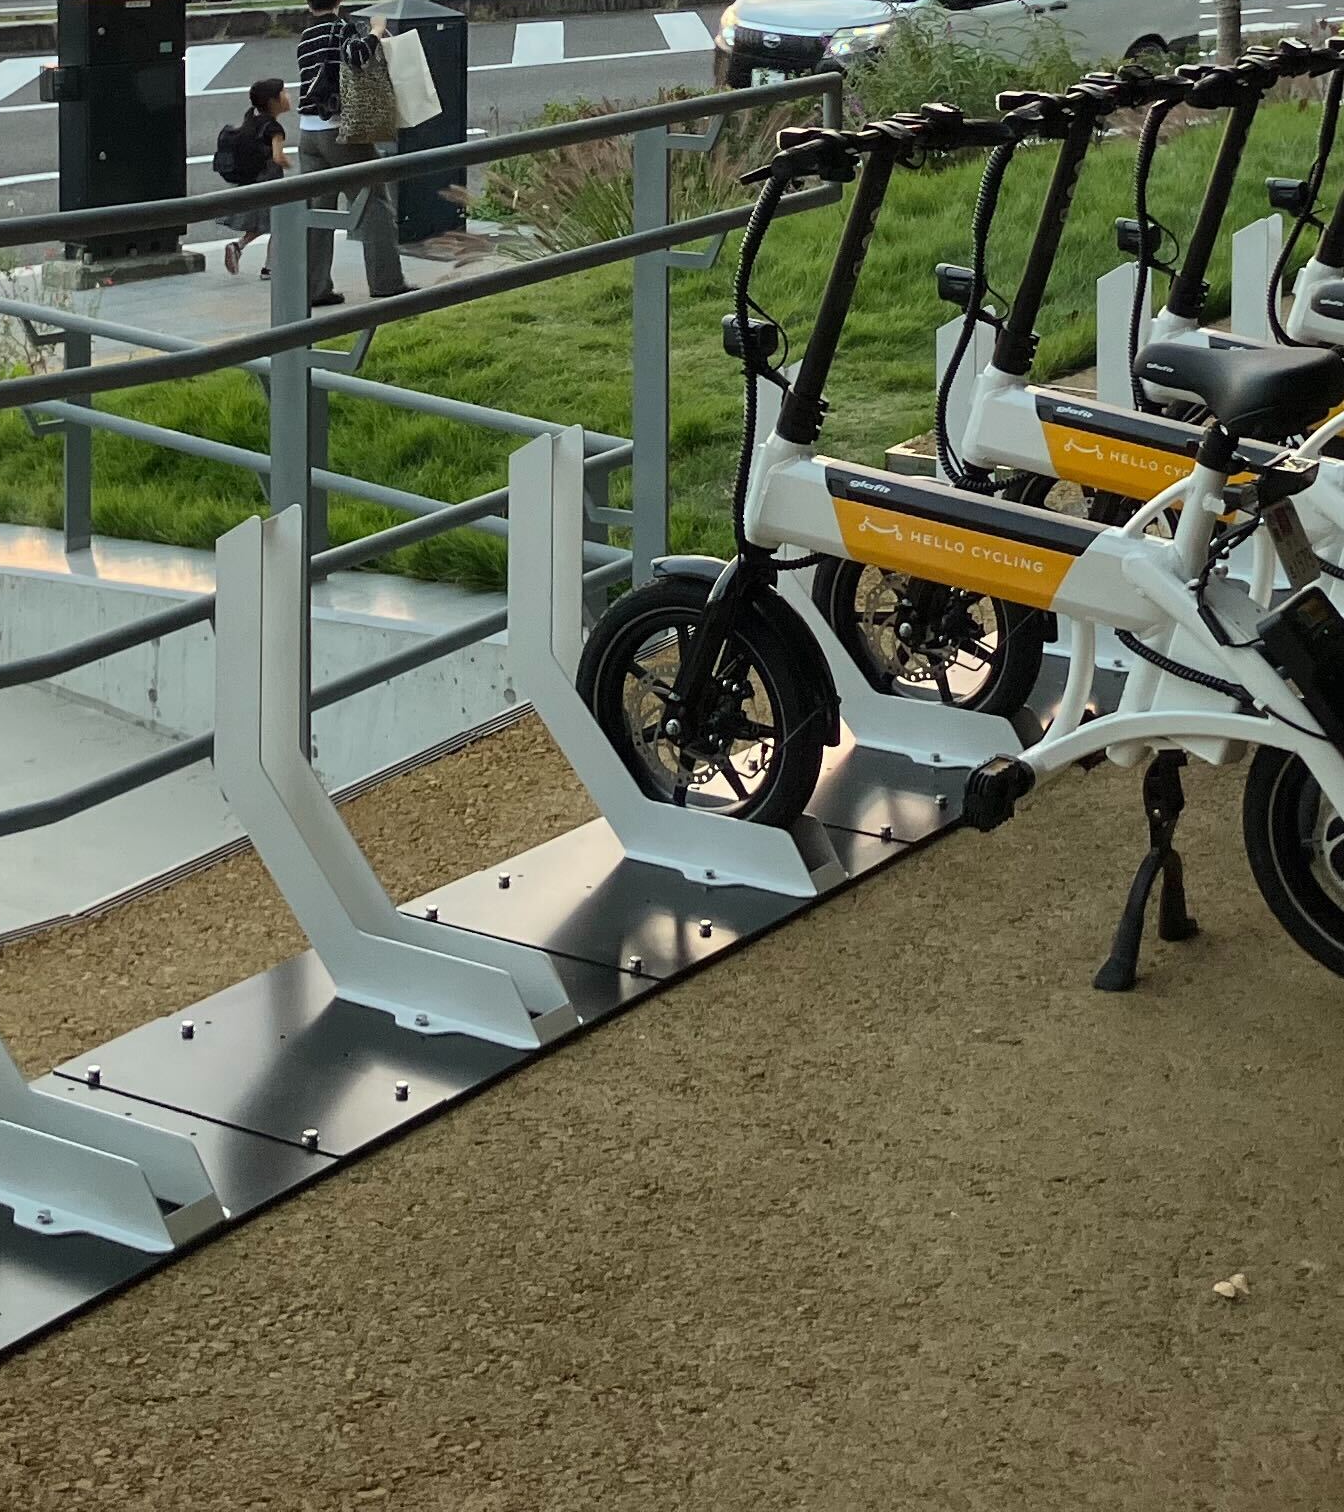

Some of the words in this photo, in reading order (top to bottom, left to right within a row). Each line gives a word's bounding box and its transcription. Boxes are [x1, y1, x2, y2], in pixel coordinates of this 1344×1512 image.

[1056, 405, 1094, 420] glafit
[1109, 450, 1158, 472] HELLO
[849, 479, 892, 495] glafit
[910, 531, 965, 554] HELLO
[971, 546, 1044, 574] CYCLING
